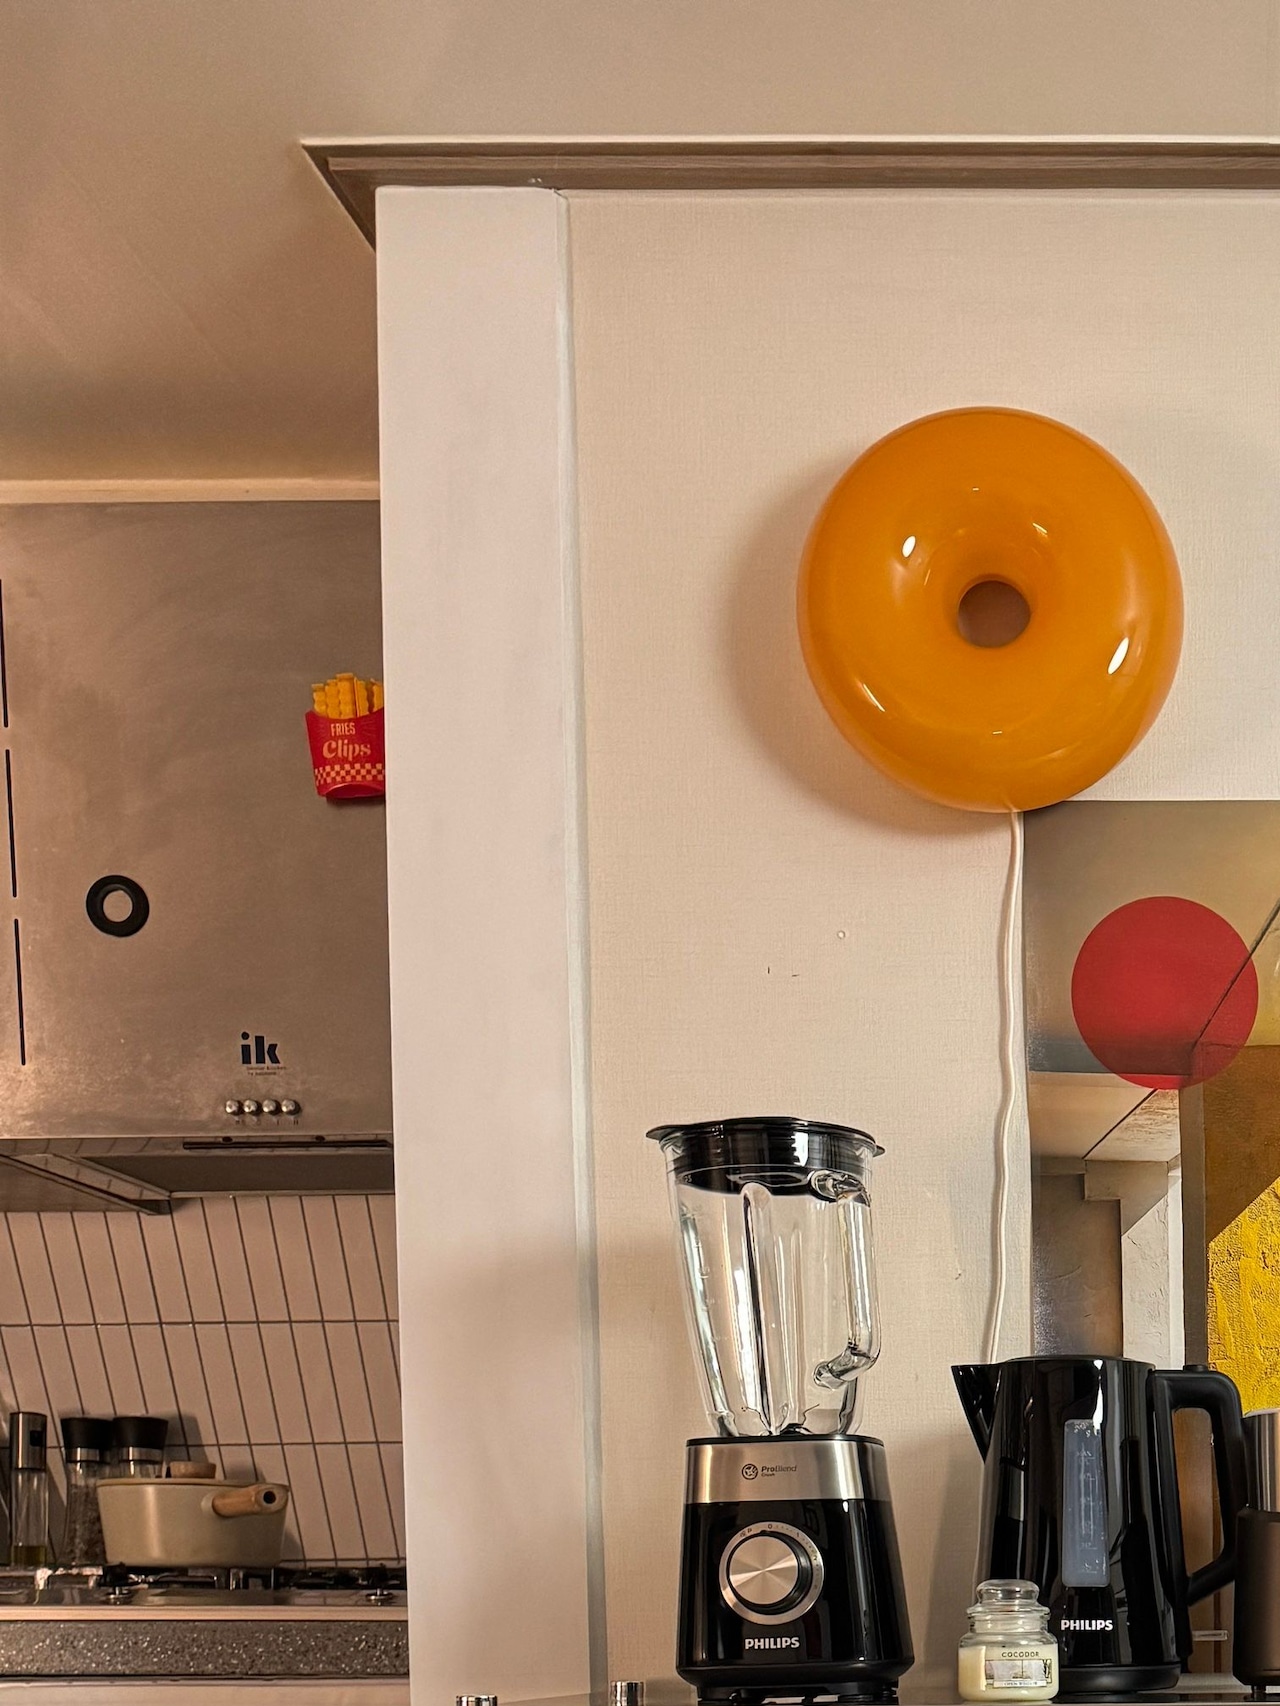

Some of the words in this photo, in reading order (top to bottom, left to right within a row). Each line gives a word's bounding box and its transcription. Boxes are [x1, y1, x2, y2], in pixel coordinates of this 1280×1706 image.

[330, 722, 356, 737] FRIES
[322, 739, 372, 761] Clips
[240, 1031, 281, 1065] ik
[761, 1465, 798, 1473] ProBlend
[1060, 1619, 1114, 1631] PHILIPS
[744, 1637, 801, 1650] PHILIPS
